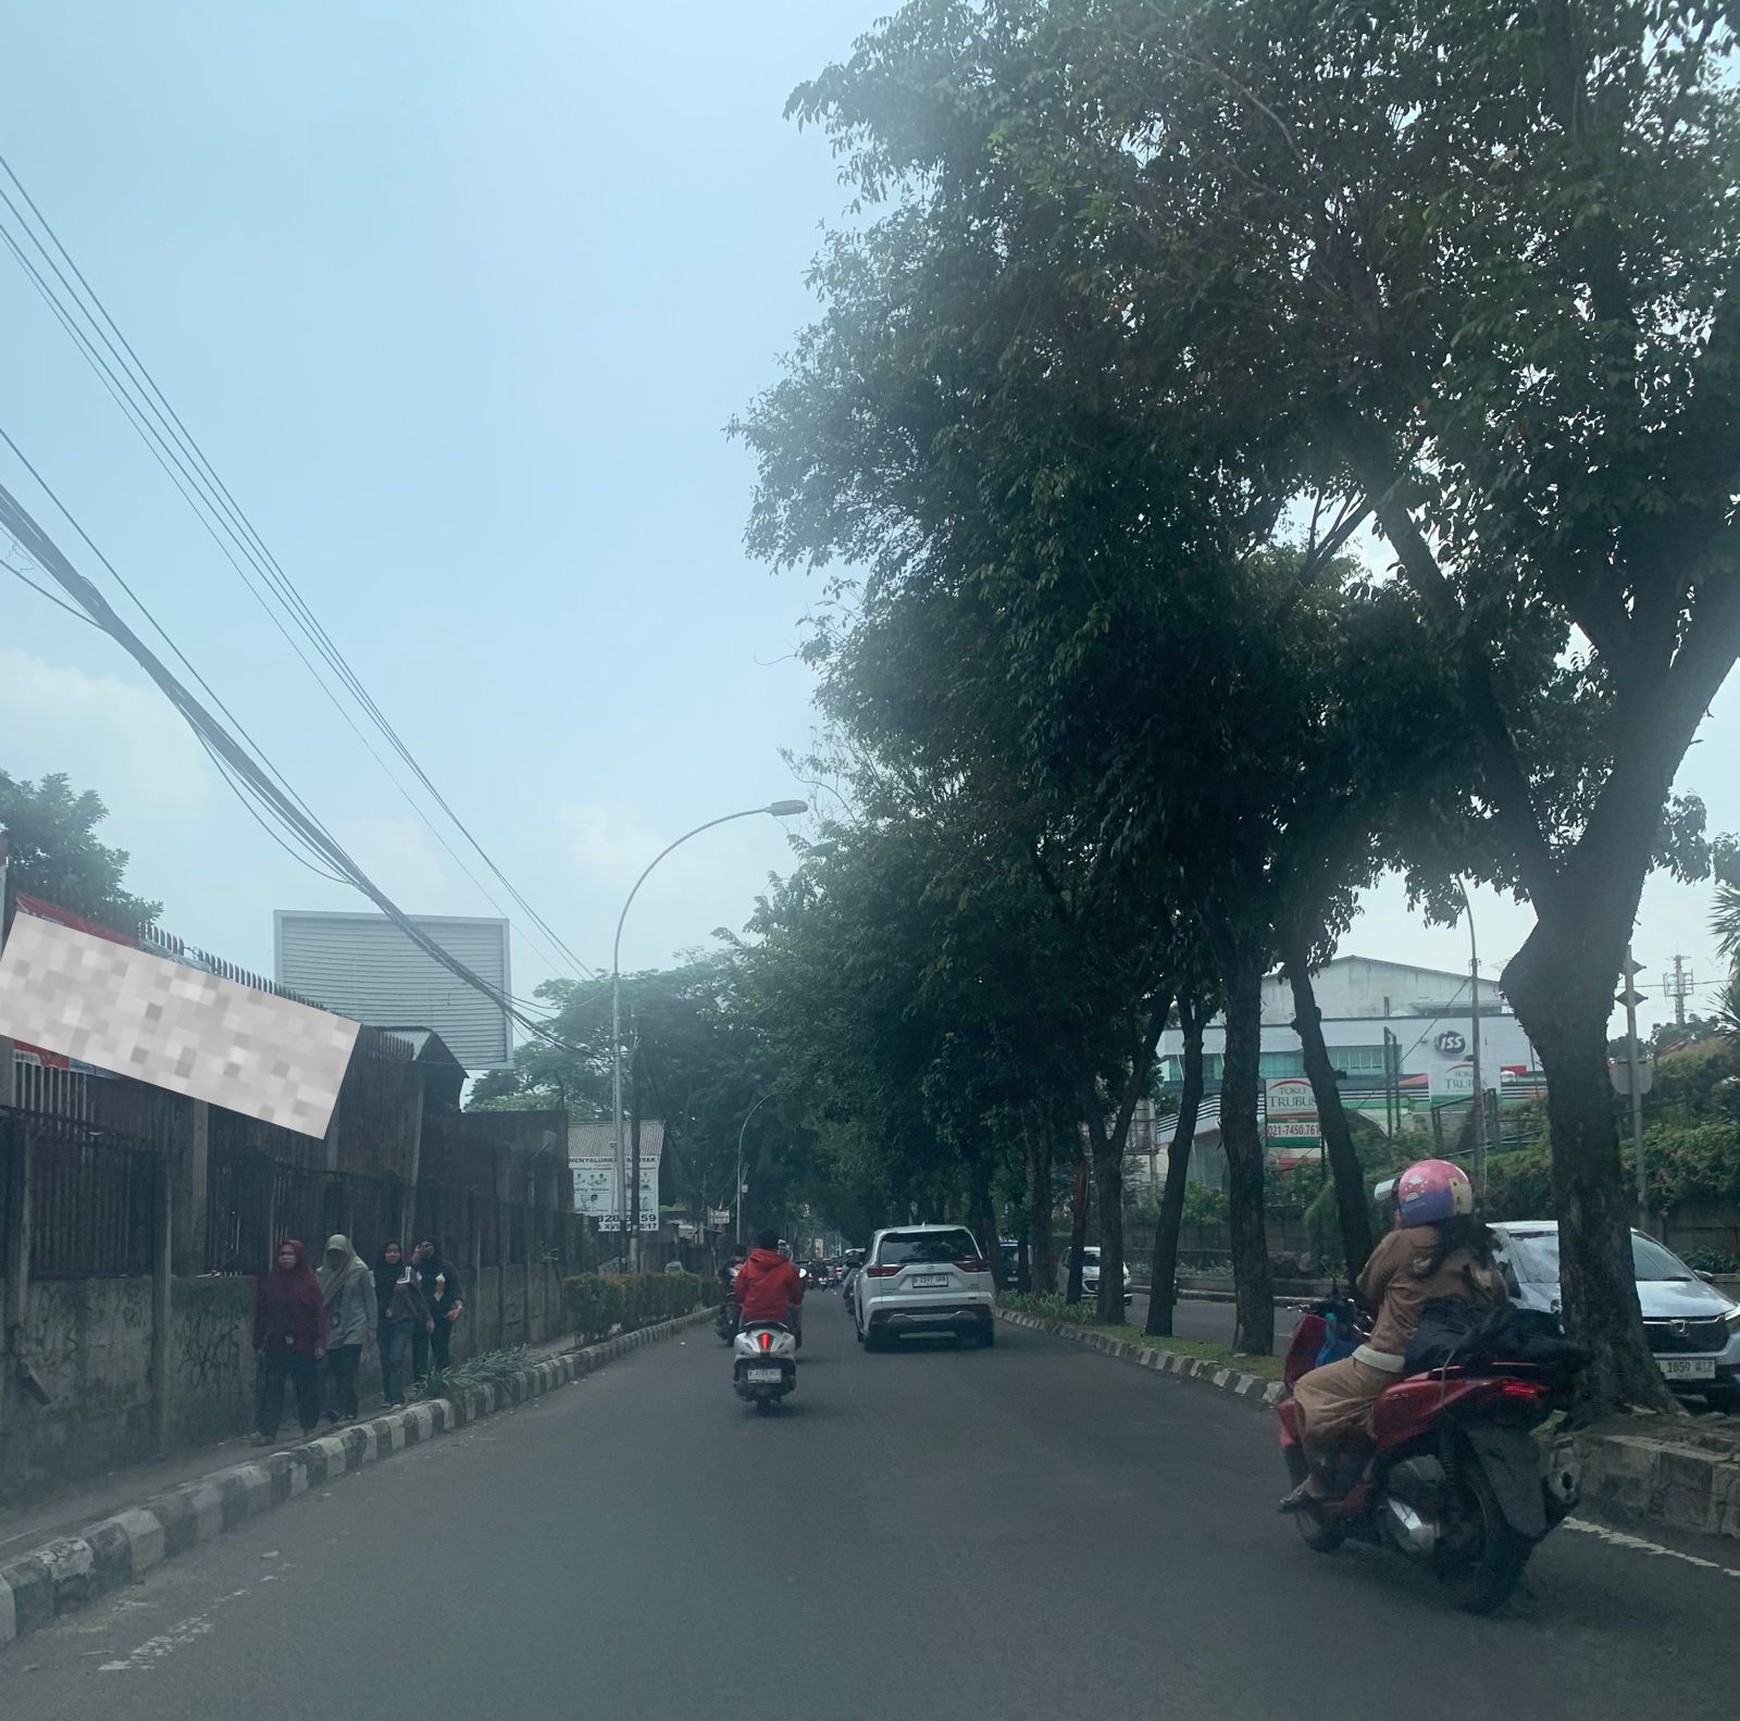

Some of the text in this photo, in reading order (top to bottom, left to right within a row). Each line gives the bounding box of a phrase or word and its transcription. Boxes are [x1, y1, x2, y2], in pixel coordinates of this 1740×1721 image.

[1440, 1036, 1463, 1050] ISS
[1280, 1086, 1306, 1095] TOKO
[1270, 1095, 1317, 1107] TRUBUS
